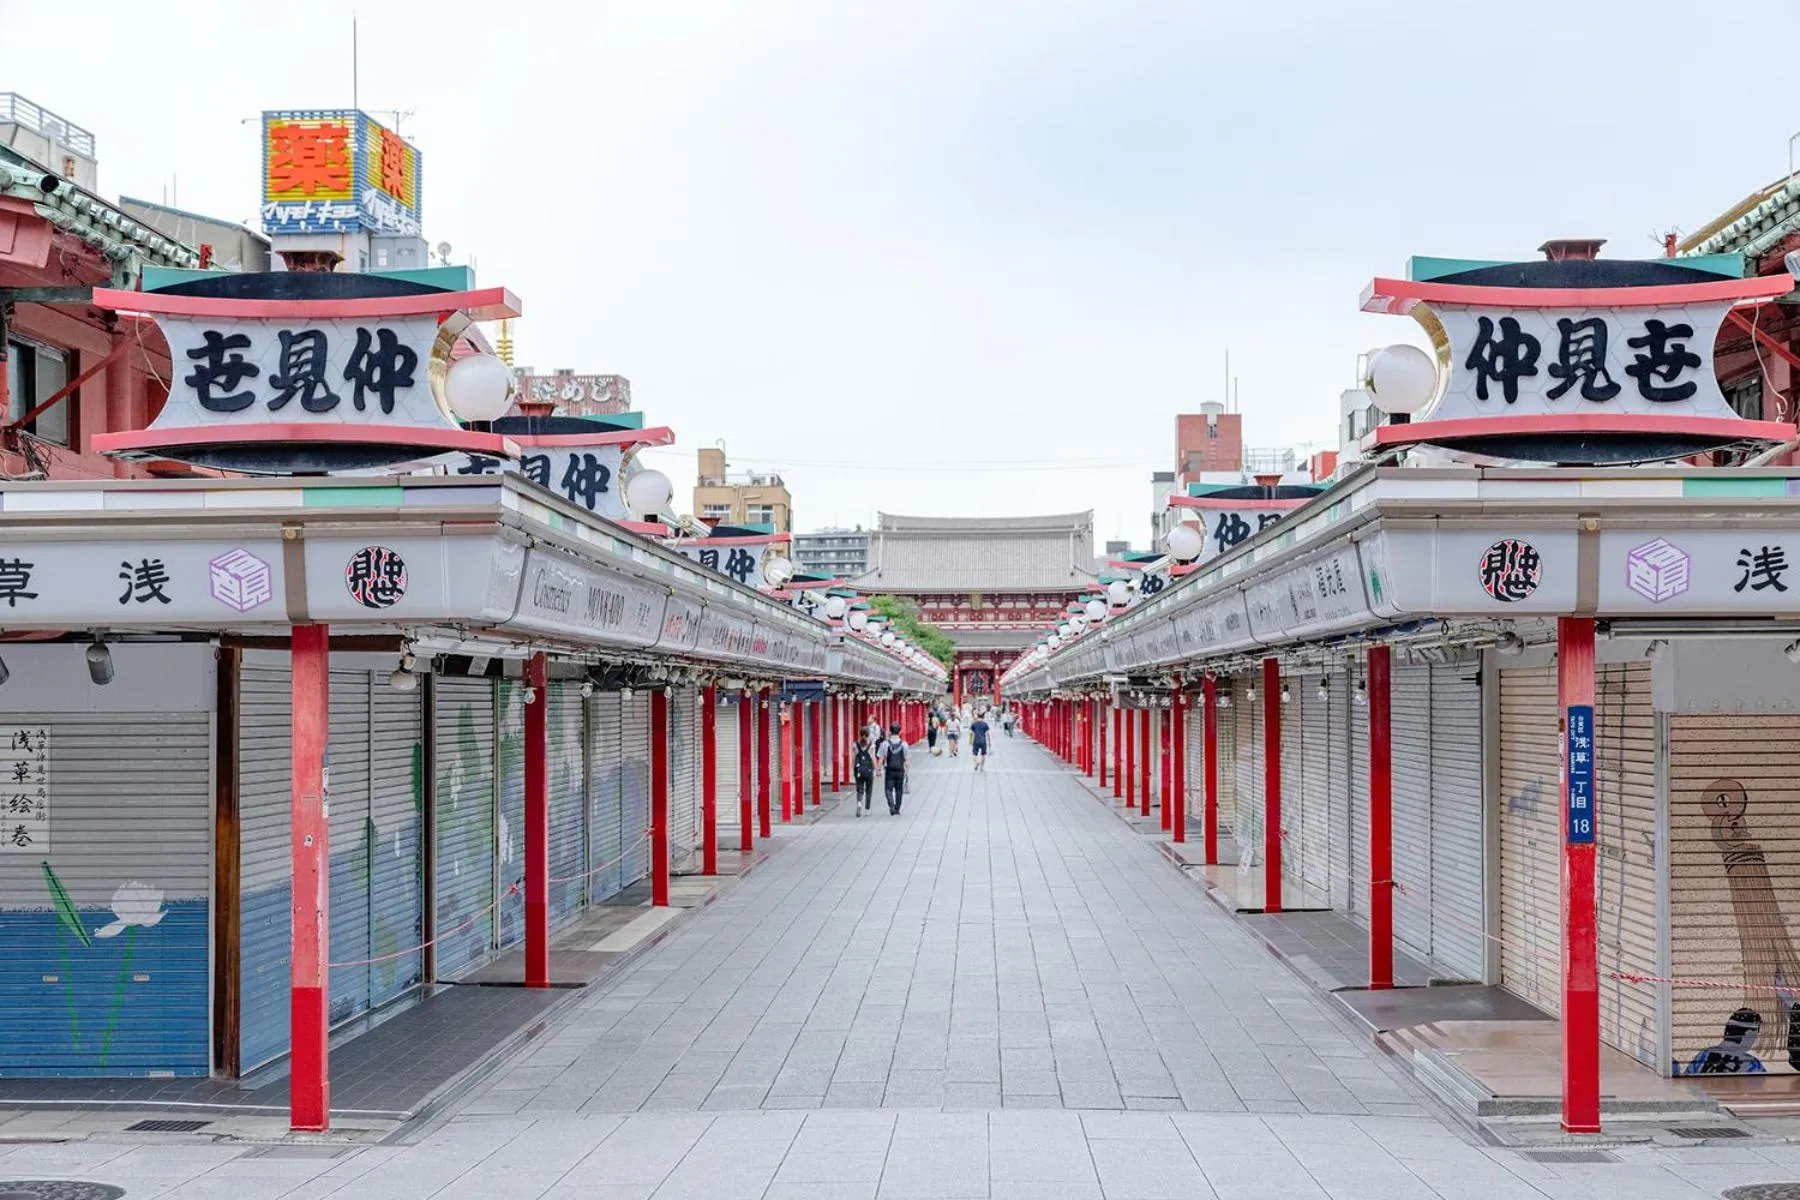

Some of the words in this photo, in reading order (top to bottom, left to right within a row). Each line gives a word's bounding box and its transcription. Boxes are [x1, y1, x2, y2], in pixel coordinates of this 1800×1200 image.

[270, 123, 349, 196] 薬
[380, 128, 405, 201] 薬
[1465, 317, 1702, 403] 仲見世
[1734, 546, 1789, 592] 浅
[9, 729, 34, 847] 浅草絵巻
[1575, 737, 1587, 808] 浅草一丁目
[1573, 819, 1590, 834] 18
